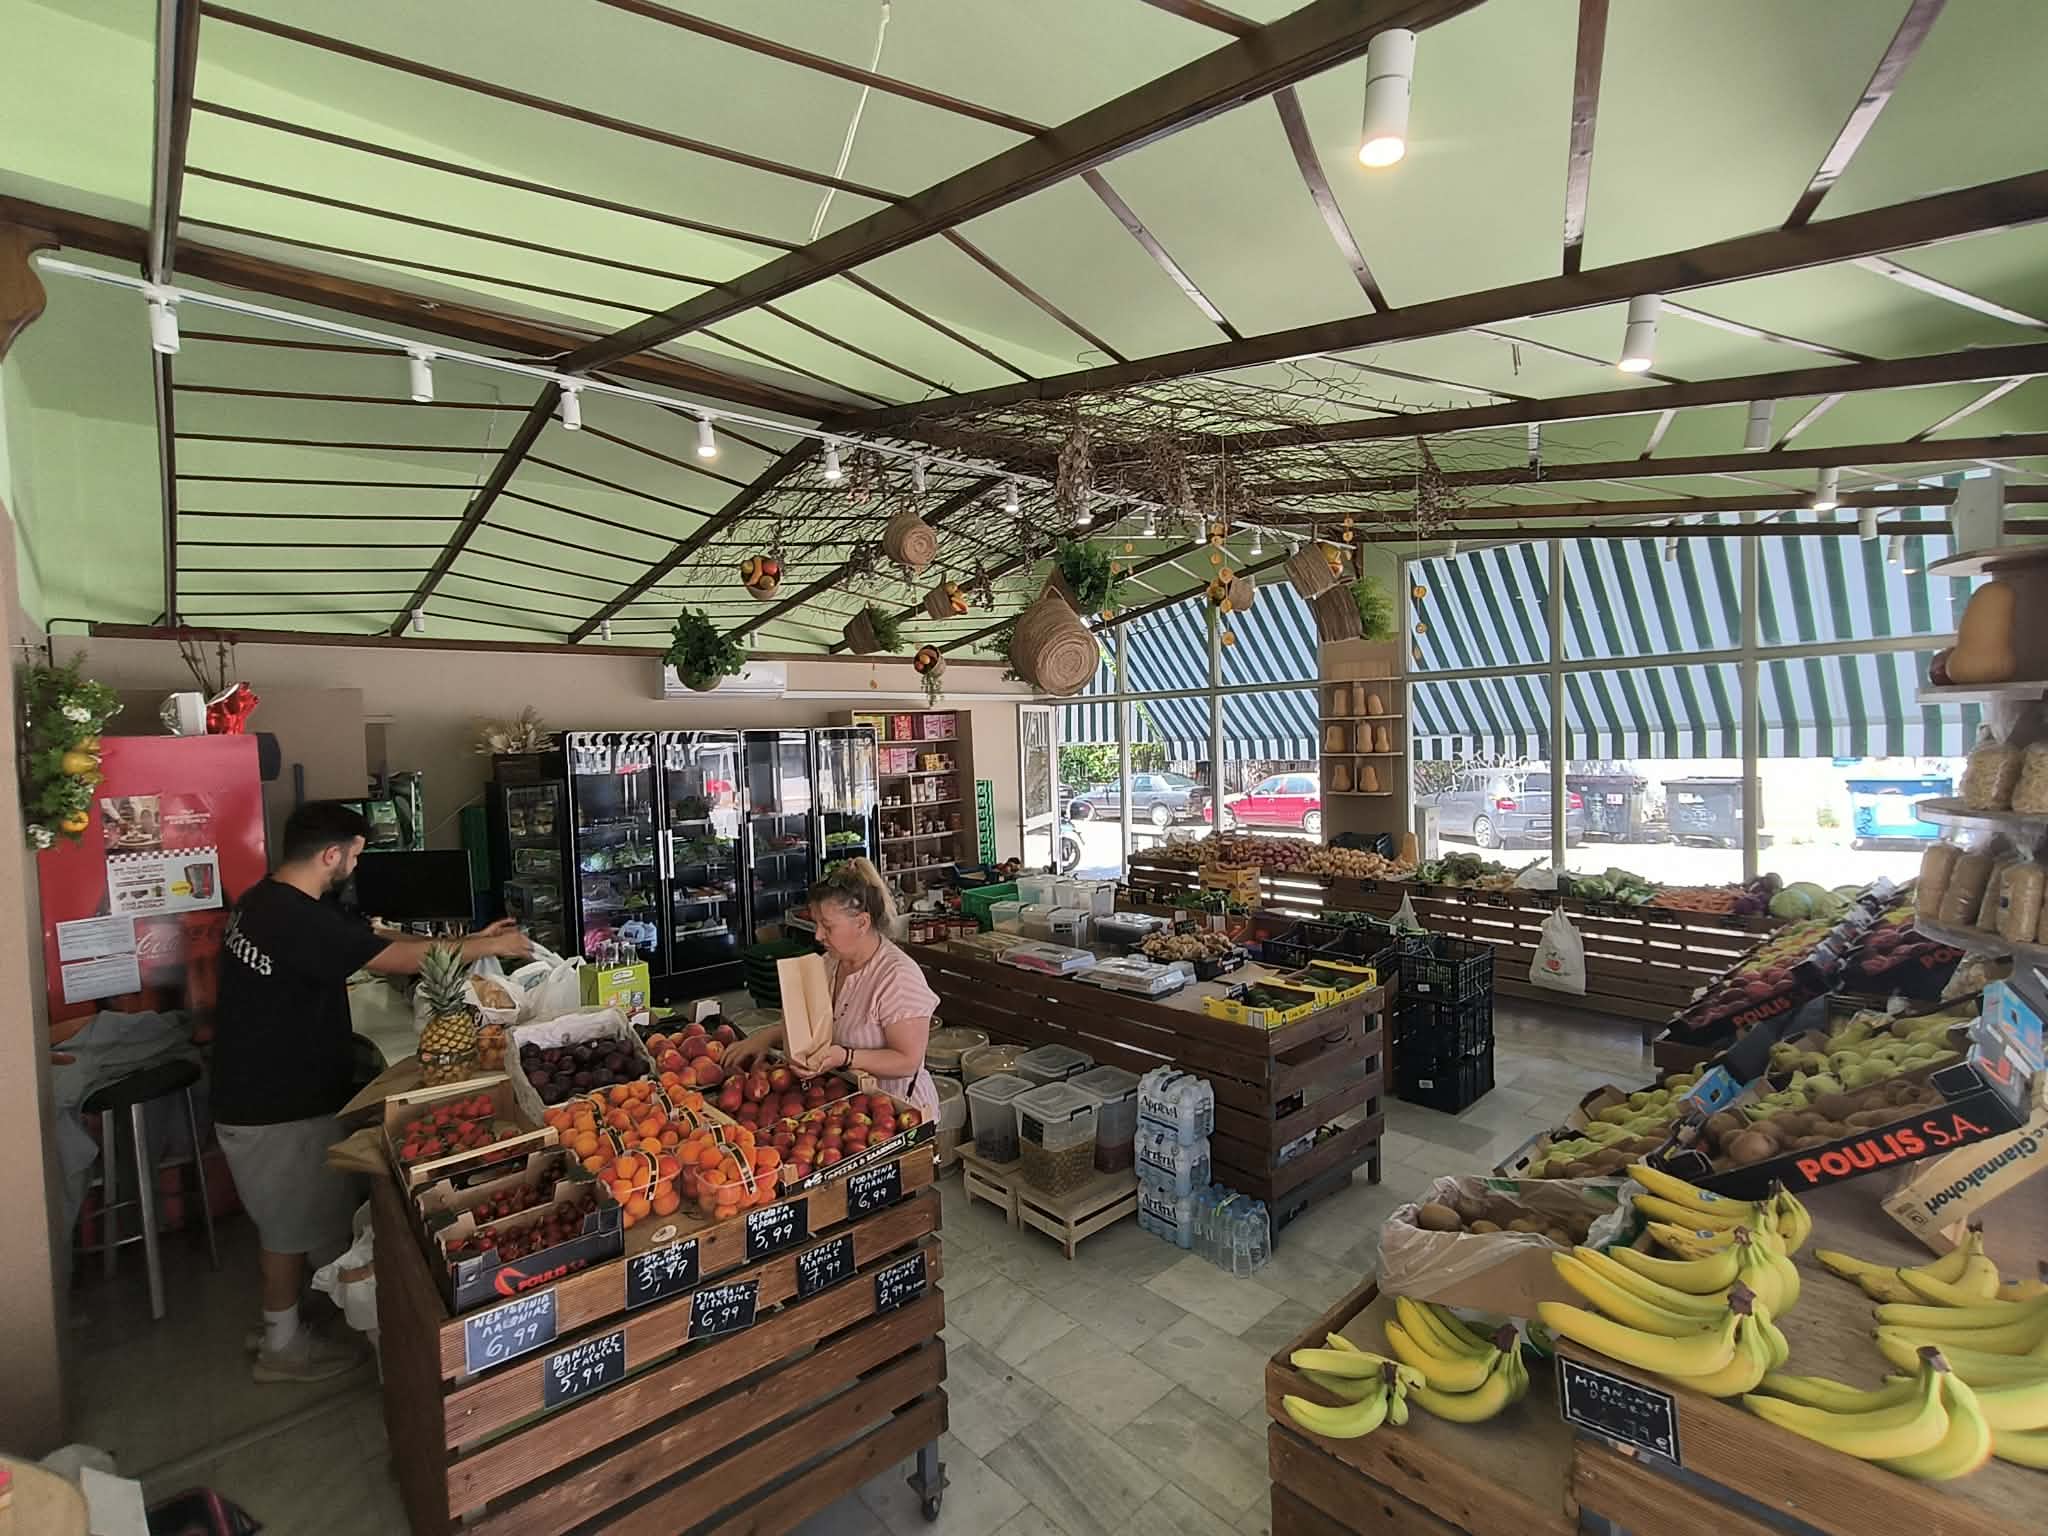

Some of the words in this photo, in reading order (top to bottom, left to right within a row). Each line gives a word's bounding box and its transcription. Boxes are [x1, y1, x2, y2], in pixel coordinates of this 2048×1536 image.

[1795, 1128, 1926, 1183] POULIS
[1922, 1113, 1991, 1146] S.A.
[1924, 1136, 2038, 1216] Giannakohori
[858, 1188, 887, 1208] 6,99
[755, 1224, 793, 1249] 5,99
[800, 1240, 842, 1265] ΚΕΡΑΣΙΑ
[517, 1264, 568, 1290] POULIS
[638, 1260, 688, 1294] 3,99
[807, 1261, 841, 1287] 7,99
[702, 1306, 739, 1332] 6,99
[486, 1322, 538, 1357] 6,99
[560, 1363, 604, 1393] 5,99
